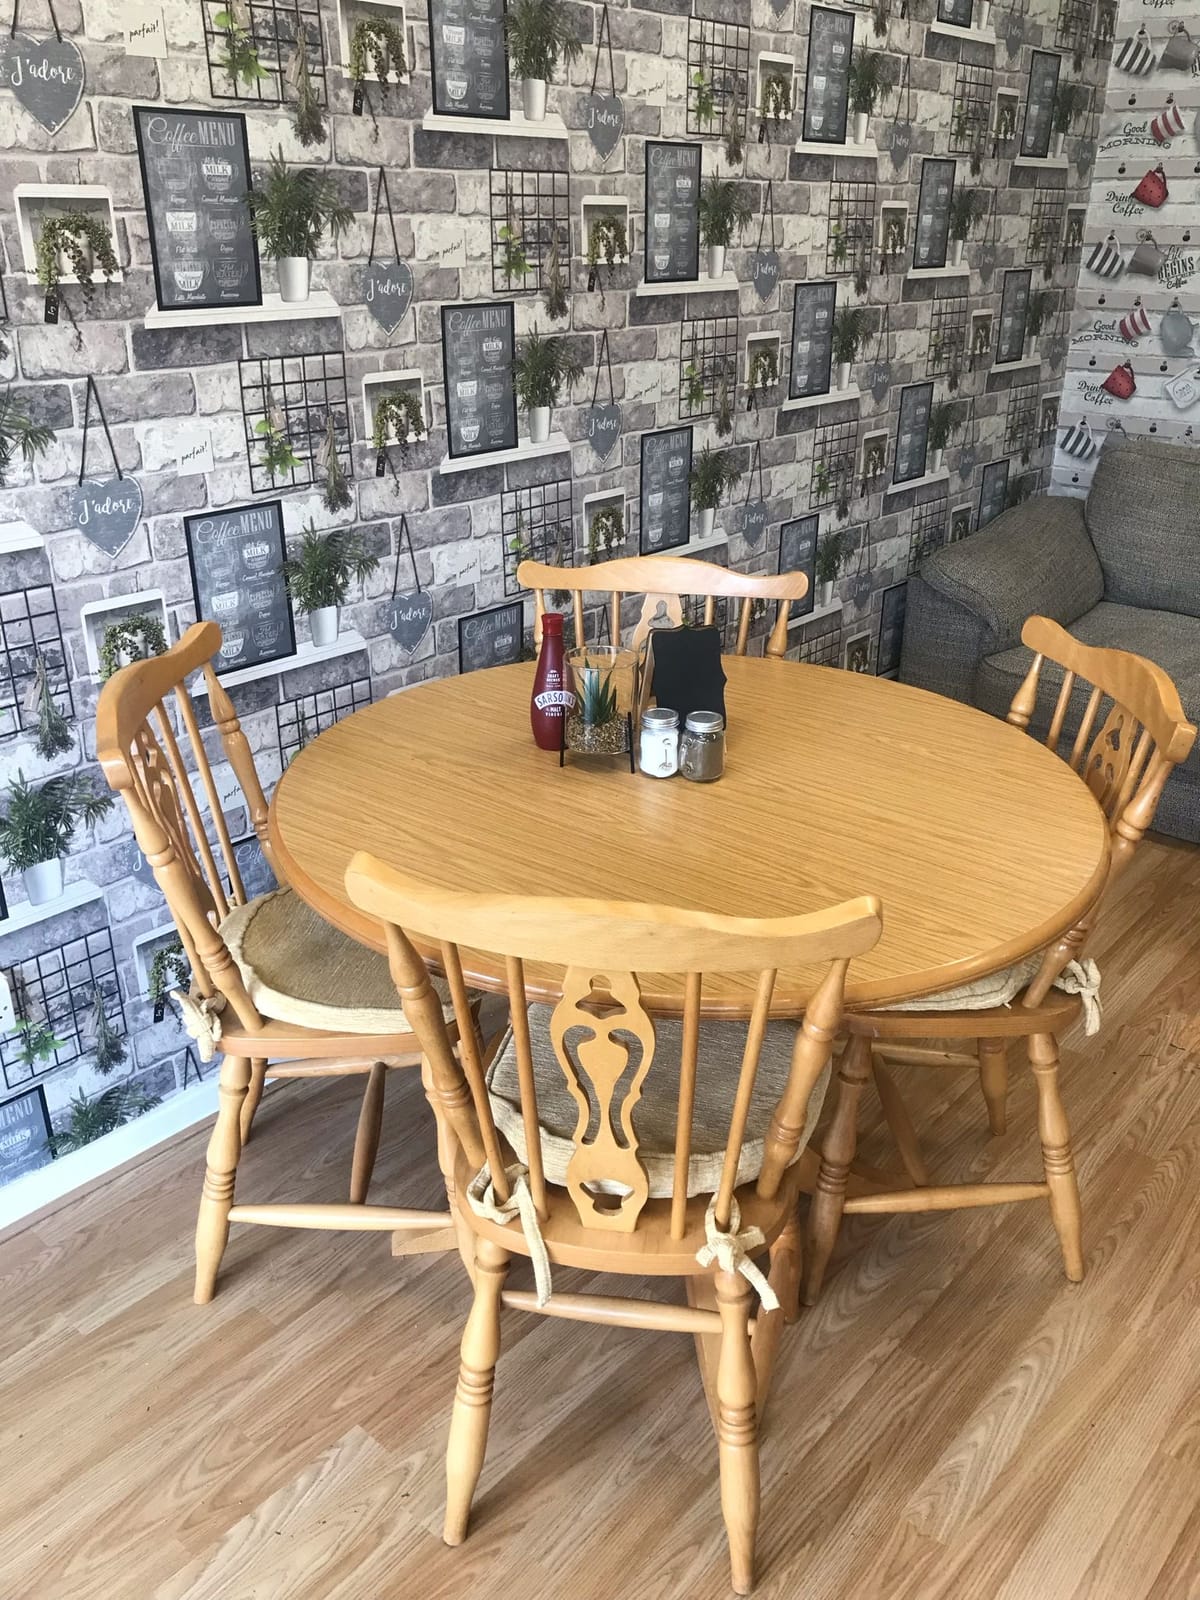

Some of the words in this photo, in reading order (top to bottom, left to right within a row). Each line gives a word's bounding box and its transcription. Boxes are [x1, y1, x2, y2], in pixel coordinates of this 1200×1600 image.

[129, 20, 160, 42] parfait!
[11, 56, 73, 86] J'adore
[147, 117, 197, 153] Coffee
[198, 121, 236, 146] MENU
[1123, 121, 1147, 137] Good
[1099, 137, 1172, 153] MORNING
[204, 165, 230, 175] MILK
[1112, 202, 1144, 216] Coffee
[170, 221, 194, 230] MILK
[366, 279, 405, 302] J'adore
[448, 311, 481, 337] Coffee
[482, 309, 507, 329] MENU
[1094, 320, 1117, 334] Good
[1072, 333, 1139, 348] MORNING
[1084, 391, 1113, 405] Coffee
[181, 441, 208, 465] parfait!
[79, 497, 133, 525] J'adore
[196, 520, 240, 547] Coffee
[240, 509, 273, 535] MENU
[245, 546, 267, 557] MILK
[391, 607, 427, 630] J'adore
[223, 785, 241, 803] parfa
[236, 845, 262, 864] Coff
